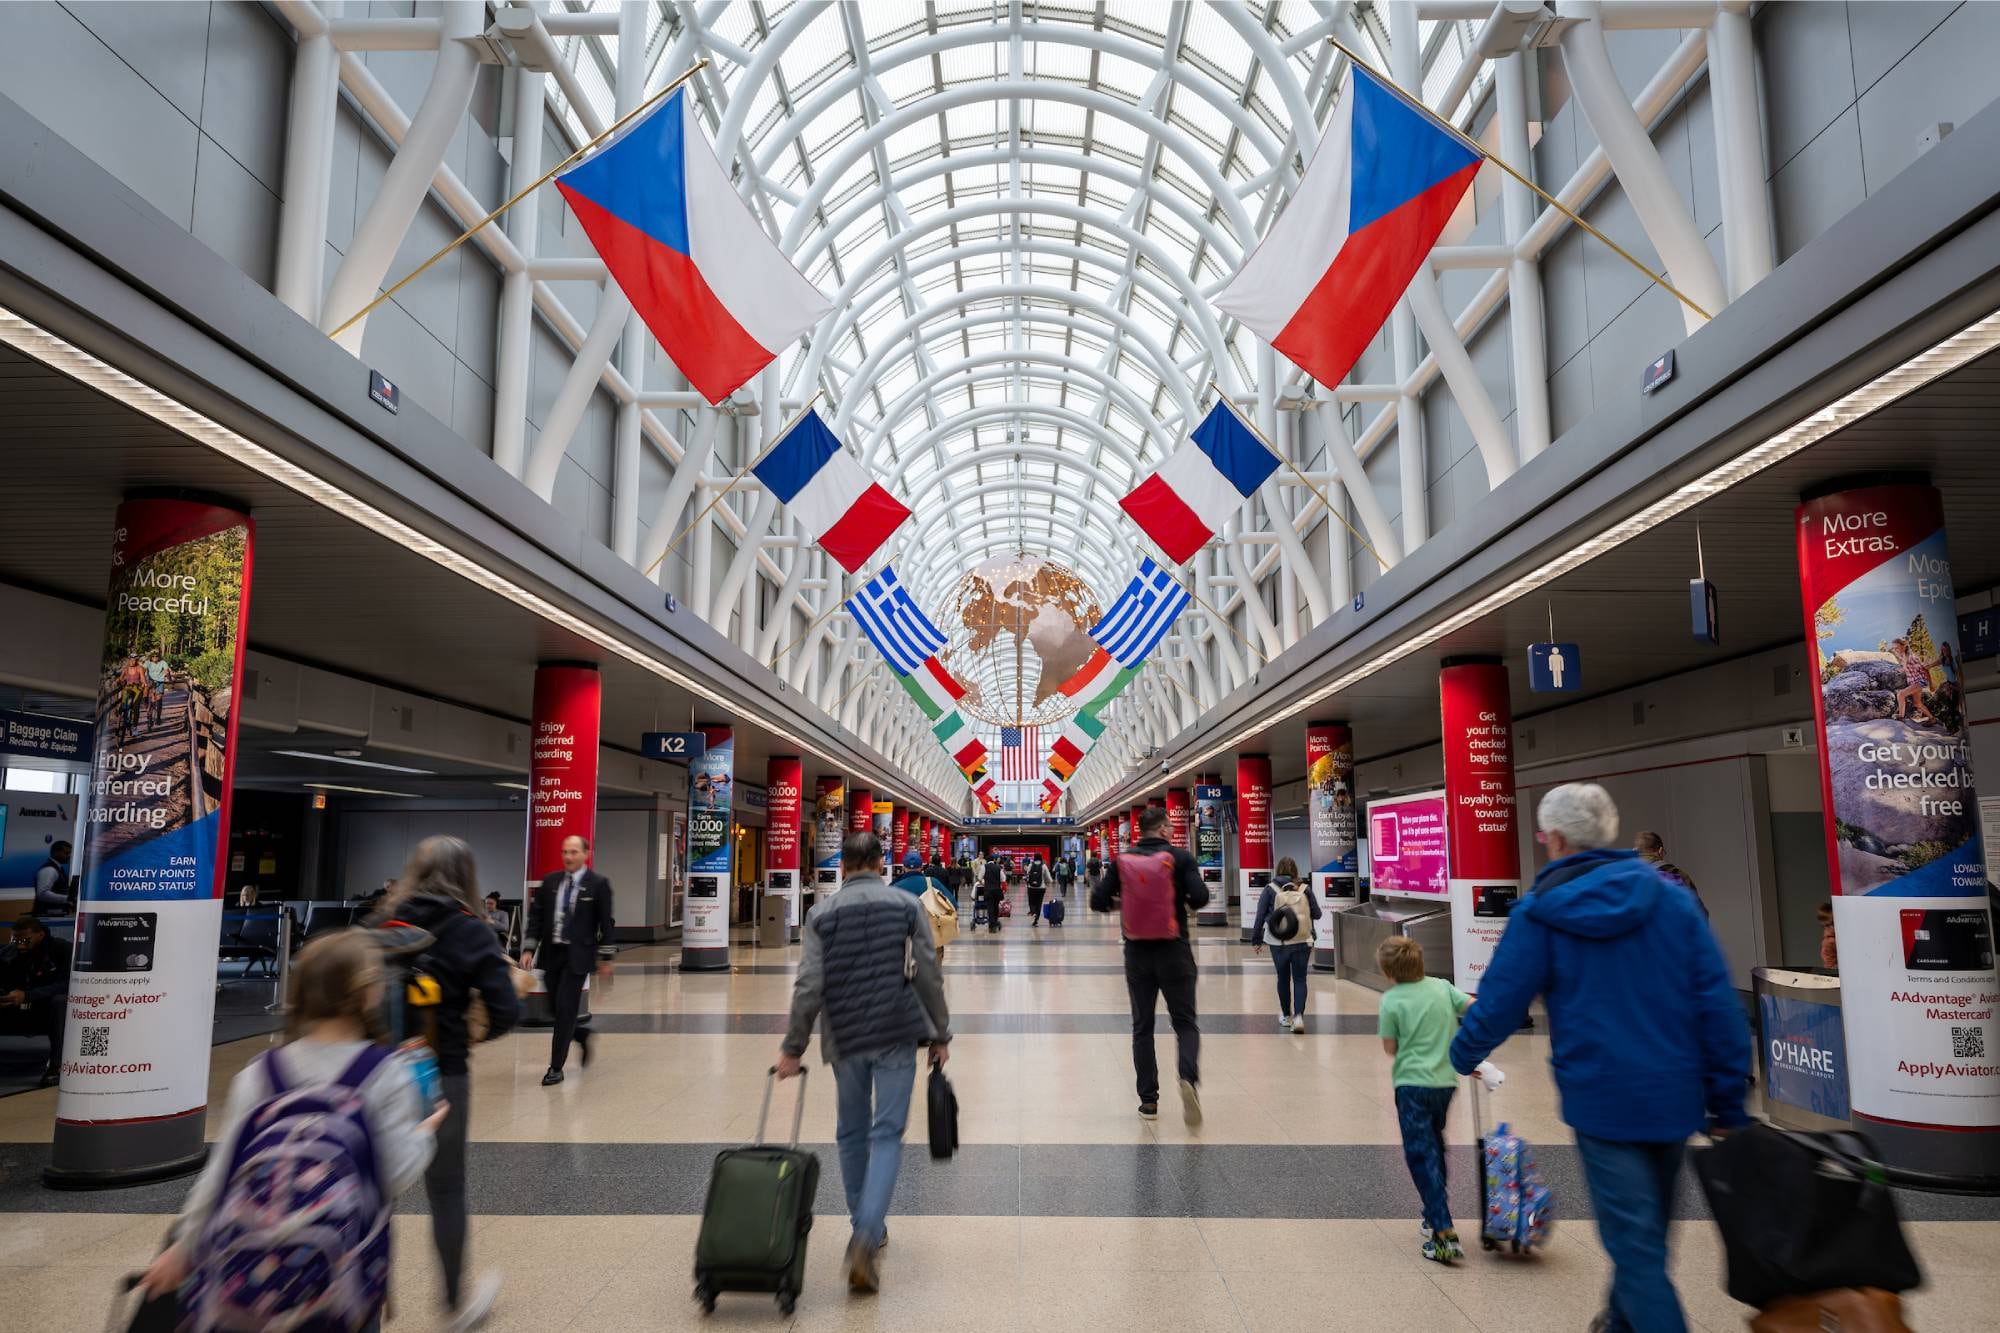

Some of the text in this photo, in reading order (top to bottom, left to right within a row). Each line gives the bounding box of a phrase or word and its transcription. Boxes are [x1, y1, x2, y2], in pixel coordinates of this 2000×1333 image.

[1823, 511, 1887, 536] More
[1825, 535, 1899, 559] Extras.
[133, 568, 197, 590] More
[1978, 620, 1988, 636] H
[1479, 711, 1496, 721] Get
[9, 721, 78, 741] Baggage Claim
[540, 722, 565, 734] Enjoy
[1466, 726, 1489, 738] your
[9, 736, 38, 748] Reclamo
[40, 741, 49, 749] de
[661, 737, 685, 753] K2
[1310, 735, 1328, 743] More
[1469, 740, 1506, 749] checked
[99, 748, 152, 774] Enjoy
[1470, 752, 1507, 765] bag free
[1858, 743, 1902, 762] Get
[1907, 744, 1956, 767] your
[540, 776, 561, 786] Earn
[1865, 767, 1959, 789] checked
[1480, 780, 1502, 790] Earn
[552, 789, 582, 800] Points
[1207, 788, 1221, 797] H3
[1459, 794, 1494, 807] Loyalty
[1920, 795, 1962, 816] free
[534, 803, 567, 813] toward
[1474, 809, 1509, 818] toward
[170, 857, 196, 866] EARN
[113, 868, 196, 878] LOYALTY POINTS
[109, 881, 156, 891] TOWARD
[90, 977, 127, 985] Conditions
[1907, 975, 1932, 983] Terms
